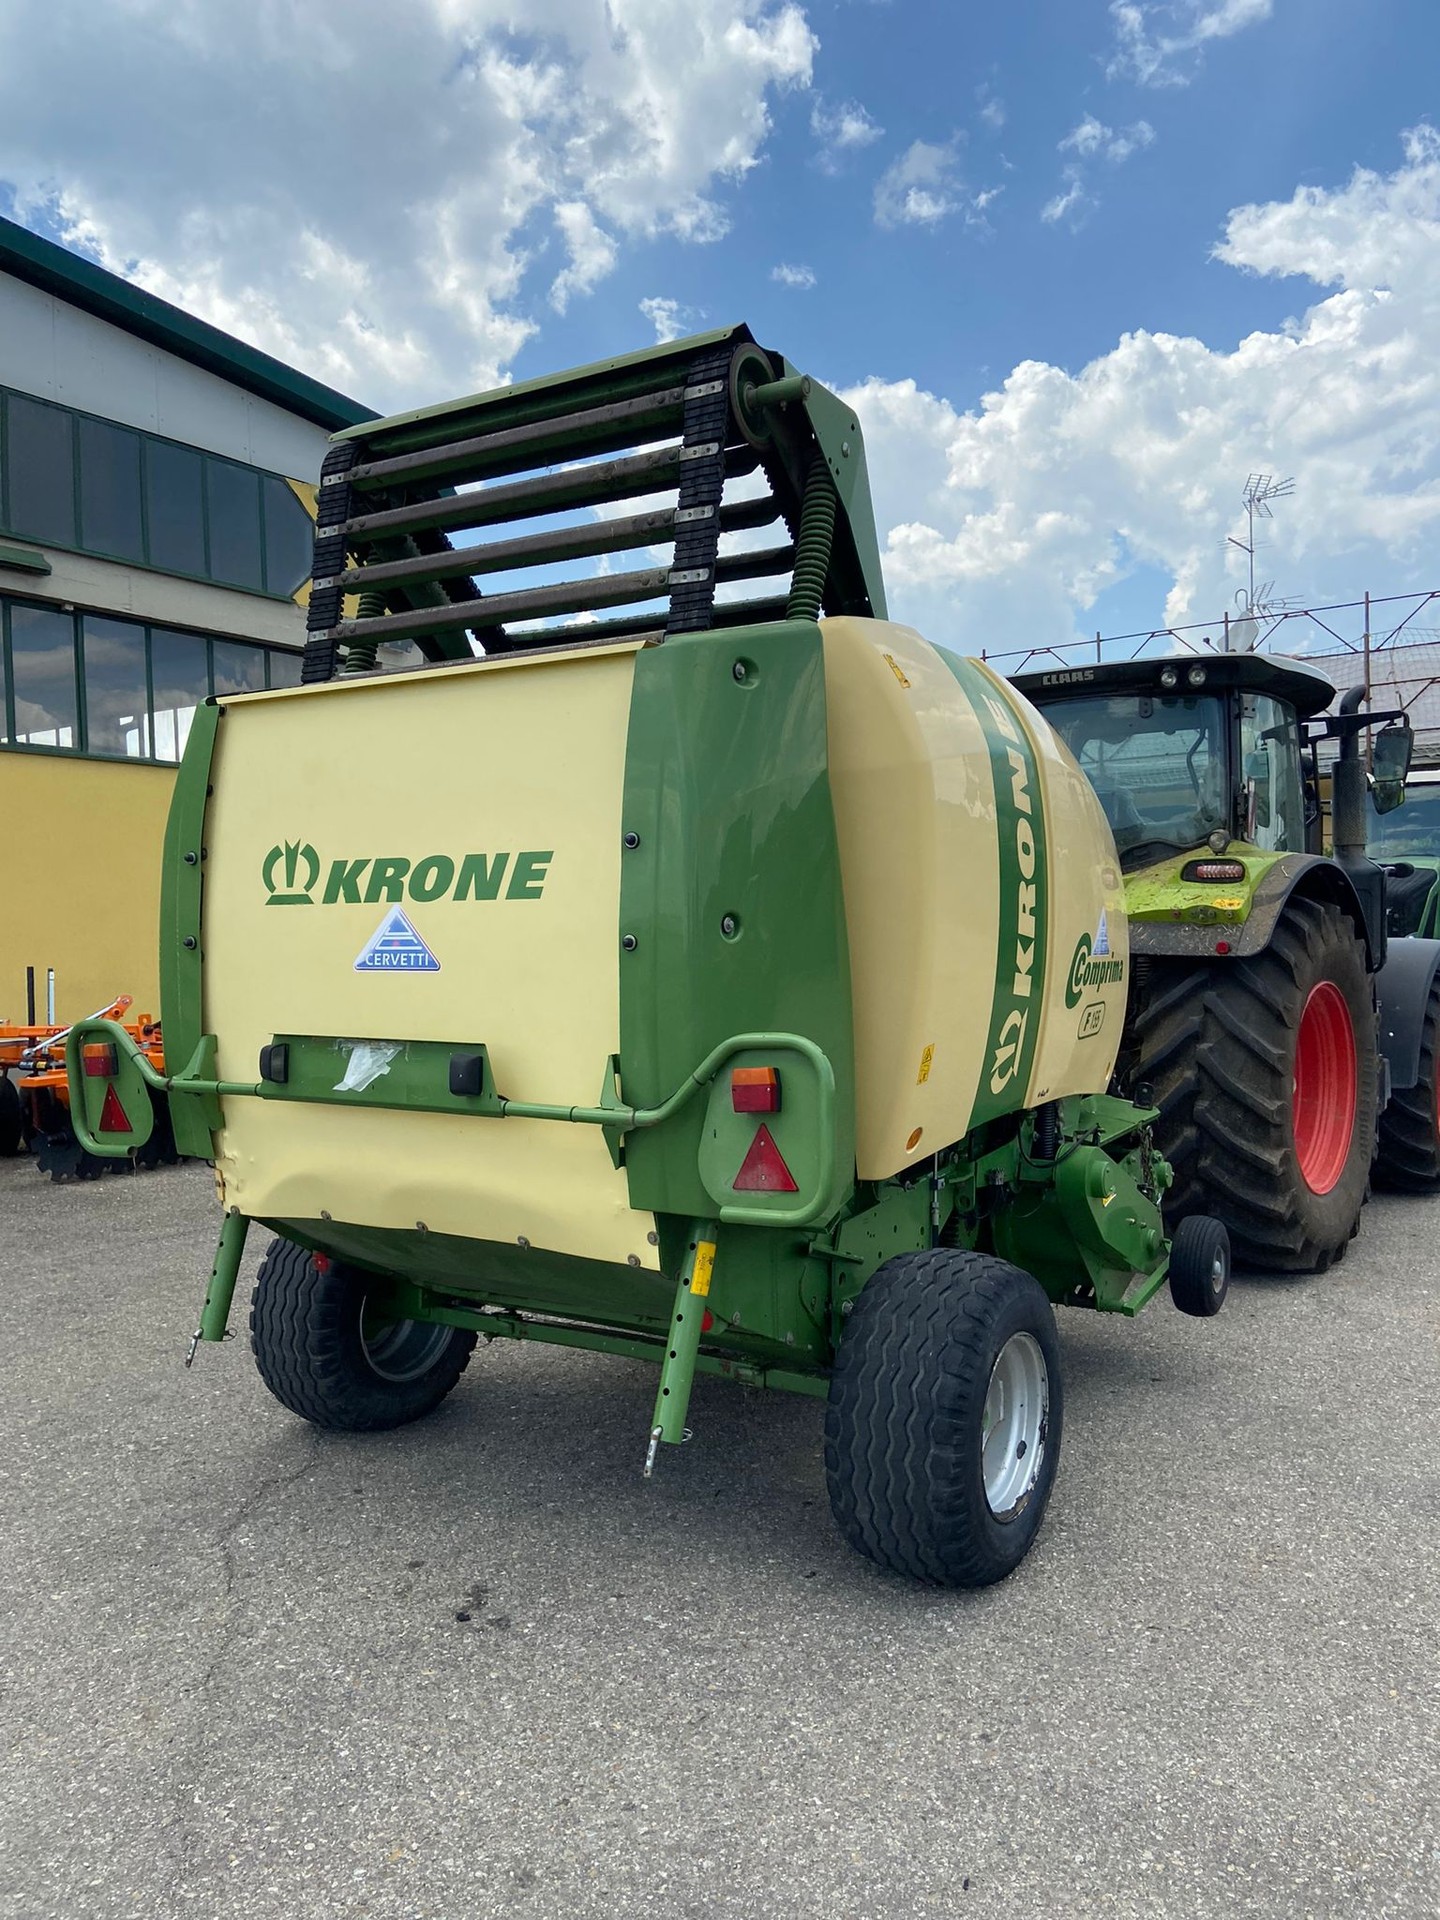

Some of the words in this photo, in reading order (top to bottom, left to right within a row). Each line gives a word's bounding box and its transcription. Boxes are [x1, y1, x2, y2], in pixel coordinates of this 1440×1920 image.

[1042, 670, 1094, 686] CLAAS
[980, 692, 1036, 998] KRONE
[321, 850, 555, 905] KRONE
[365, 953, 429, 966] CERVETTI
[1073, 951, 1124, 993] Comprima
[1083, 1011, 1092, 1032] F
